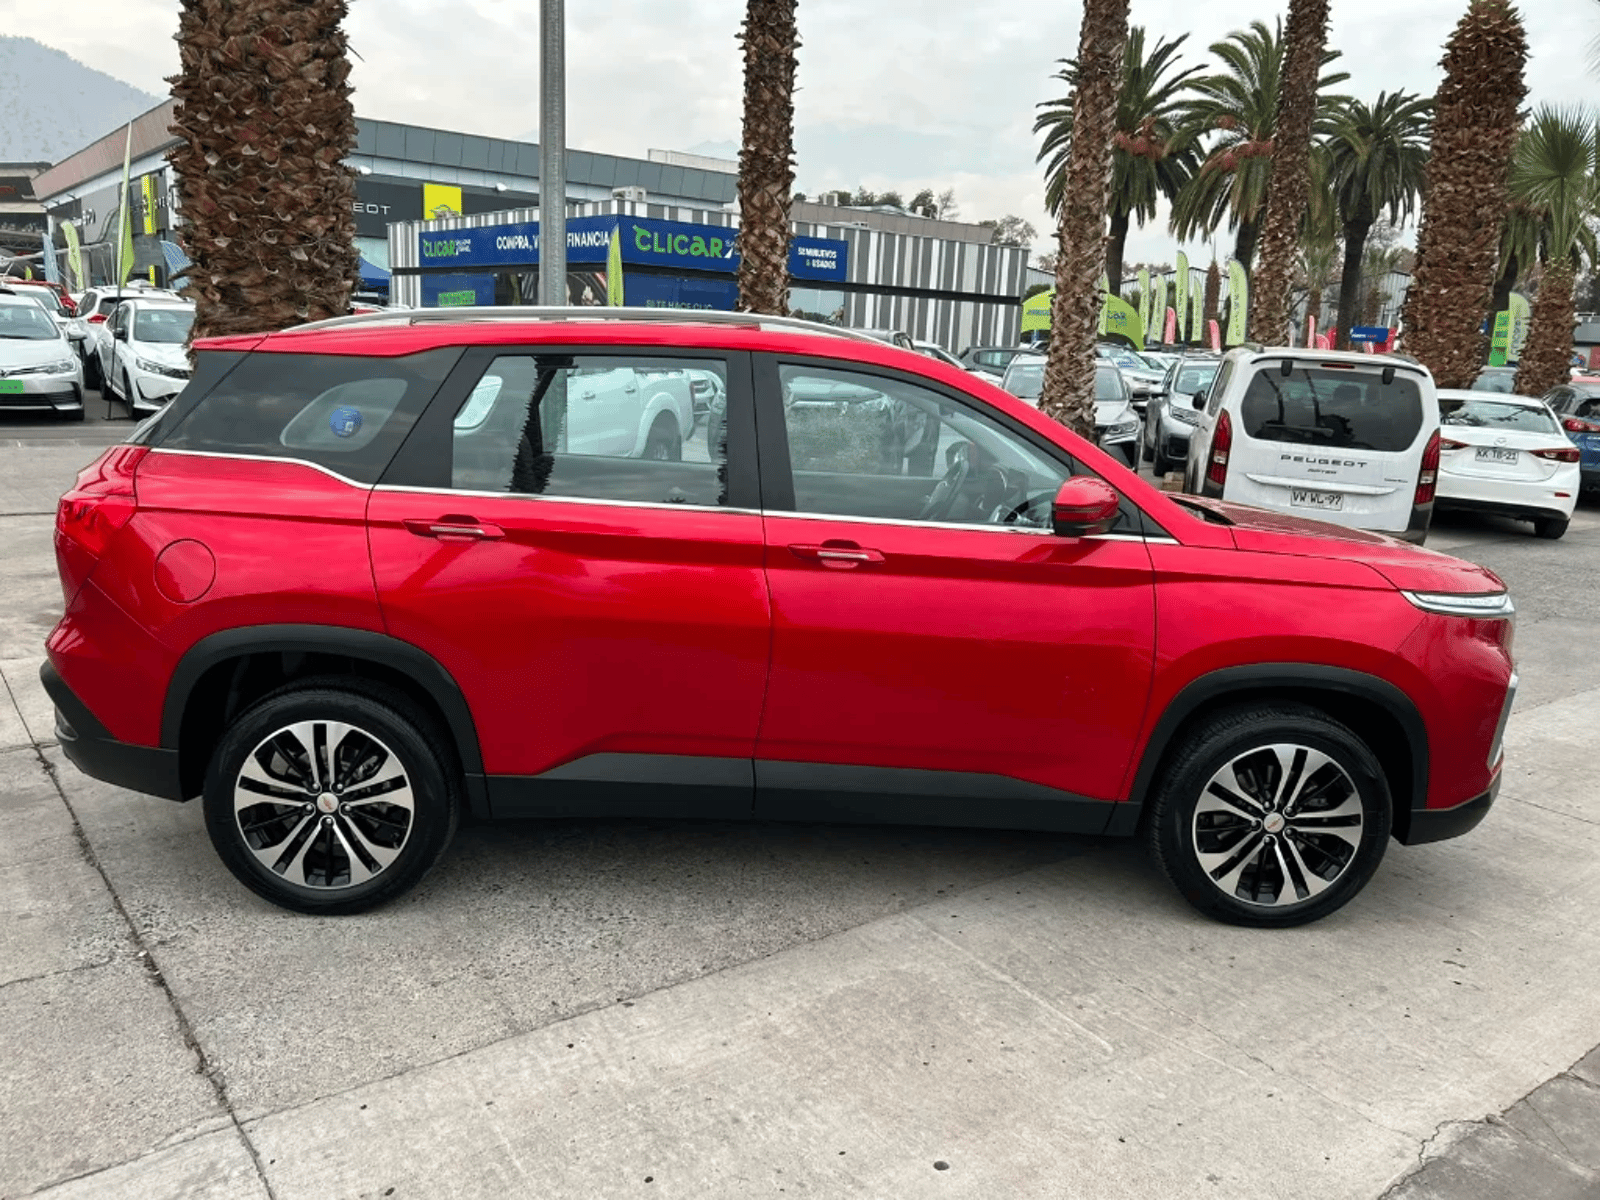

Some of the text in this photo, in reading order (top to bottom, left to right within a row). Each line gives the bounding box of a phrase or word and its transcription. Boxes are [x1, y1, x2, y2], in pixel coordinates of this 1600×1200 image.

[566, 231, 611, 248] FINANCIA
[797, 246, 837, 259] SEMINUEVOS
[811, 259, 837, 270] USADOS
[1280, 454, 1368, 468] PEUGEOT
